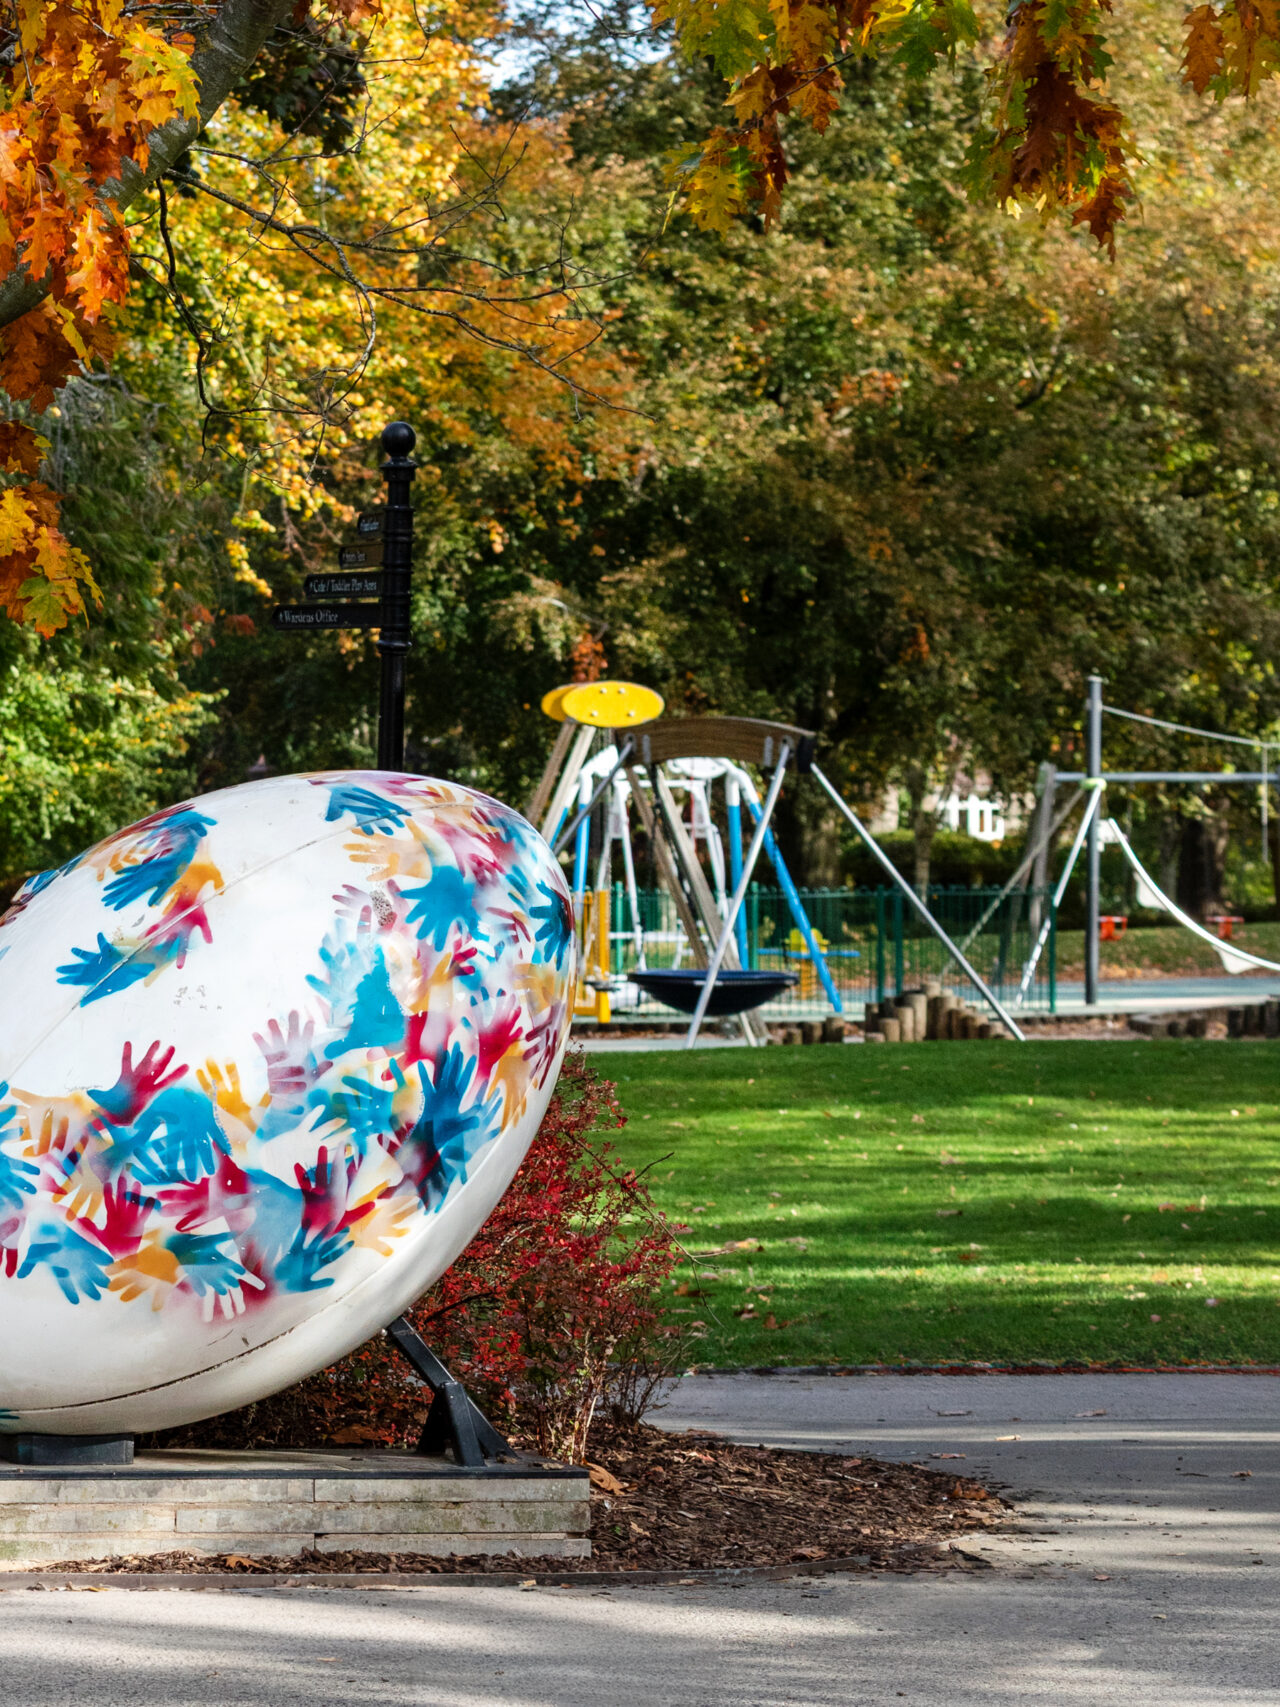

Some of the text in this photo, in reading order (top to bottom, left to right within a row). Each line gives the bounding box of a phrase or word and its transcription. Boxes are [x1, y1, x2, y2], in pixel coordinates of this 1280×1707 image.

[331, 578, 351, 592] Toddler
[351, 578, 363, 593] Play
[315, 608, 339, 623] Office
